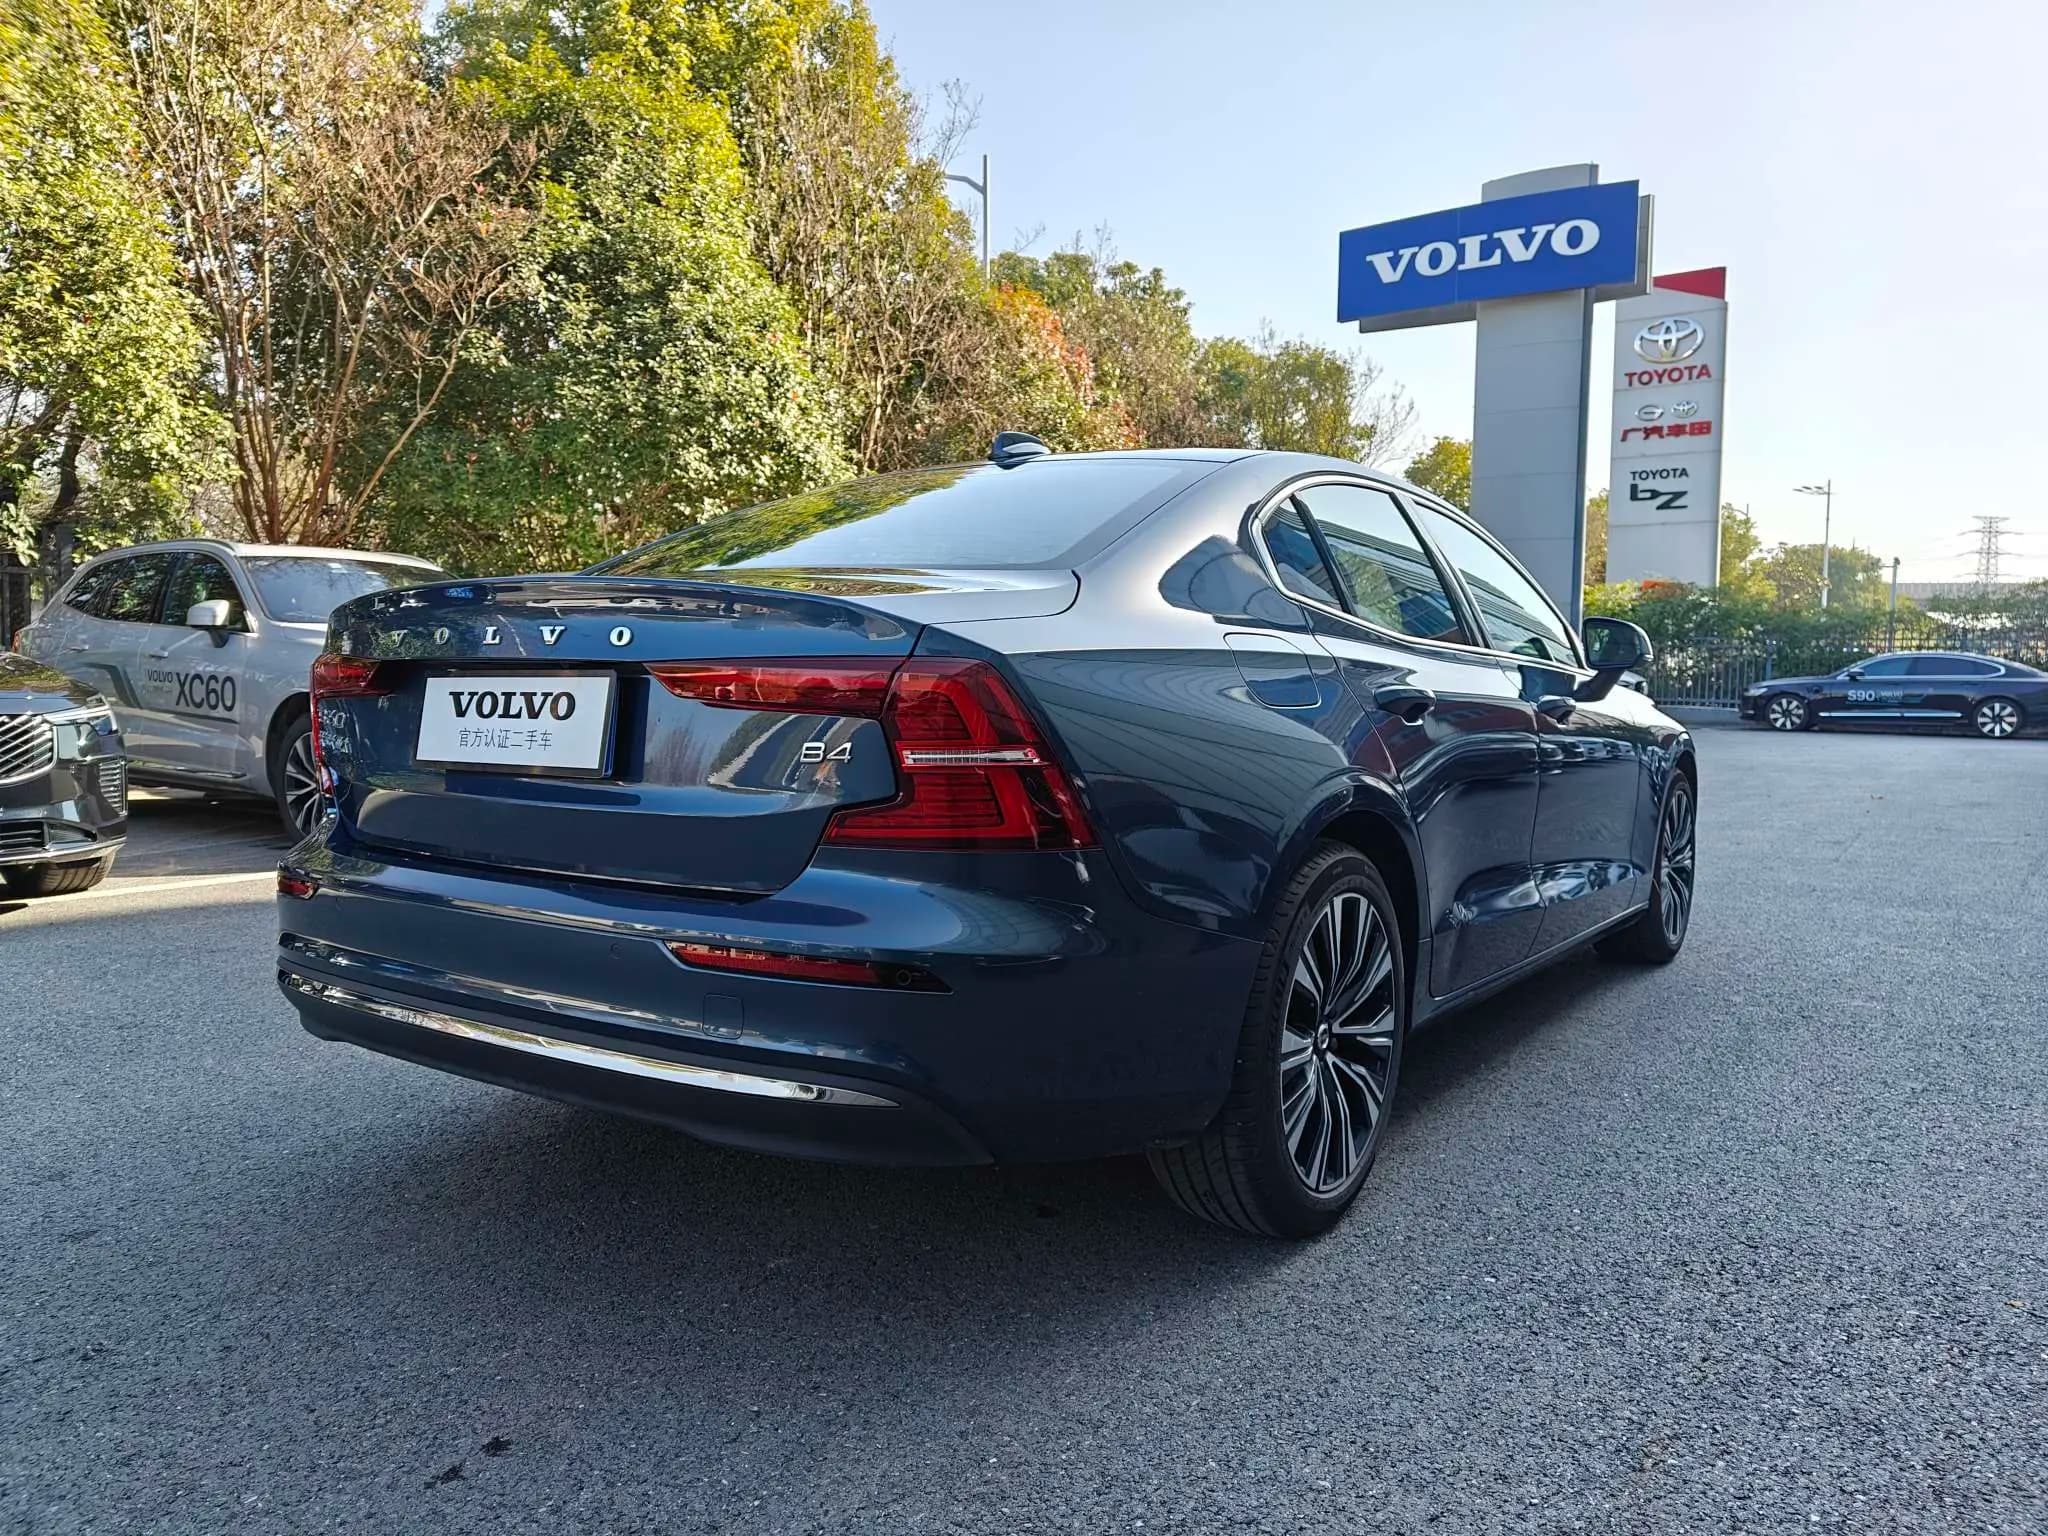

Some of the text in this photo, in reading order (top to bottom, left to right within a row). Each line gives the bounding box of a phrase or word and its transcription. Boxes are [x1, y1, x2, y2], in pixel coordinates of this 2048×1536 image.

[1366, 218, 1600, 284] VOLVO
[1624, 364, 1712, 387] TOYOTA
[1620, 421, 1713, 442] 广汽丰田
[1630, 468, 1689, 481] TOYOTA
[391, 626, 634, 647] VOLVO
[147, 669, 236, 712] VOLVO XC60
[1847, 689, 1876, 702] S90
[449, 691, 576, 721] VOLVO
[459, 728, 553, 751] 官方认证二手车
[800, 742, 852, 763] B4
